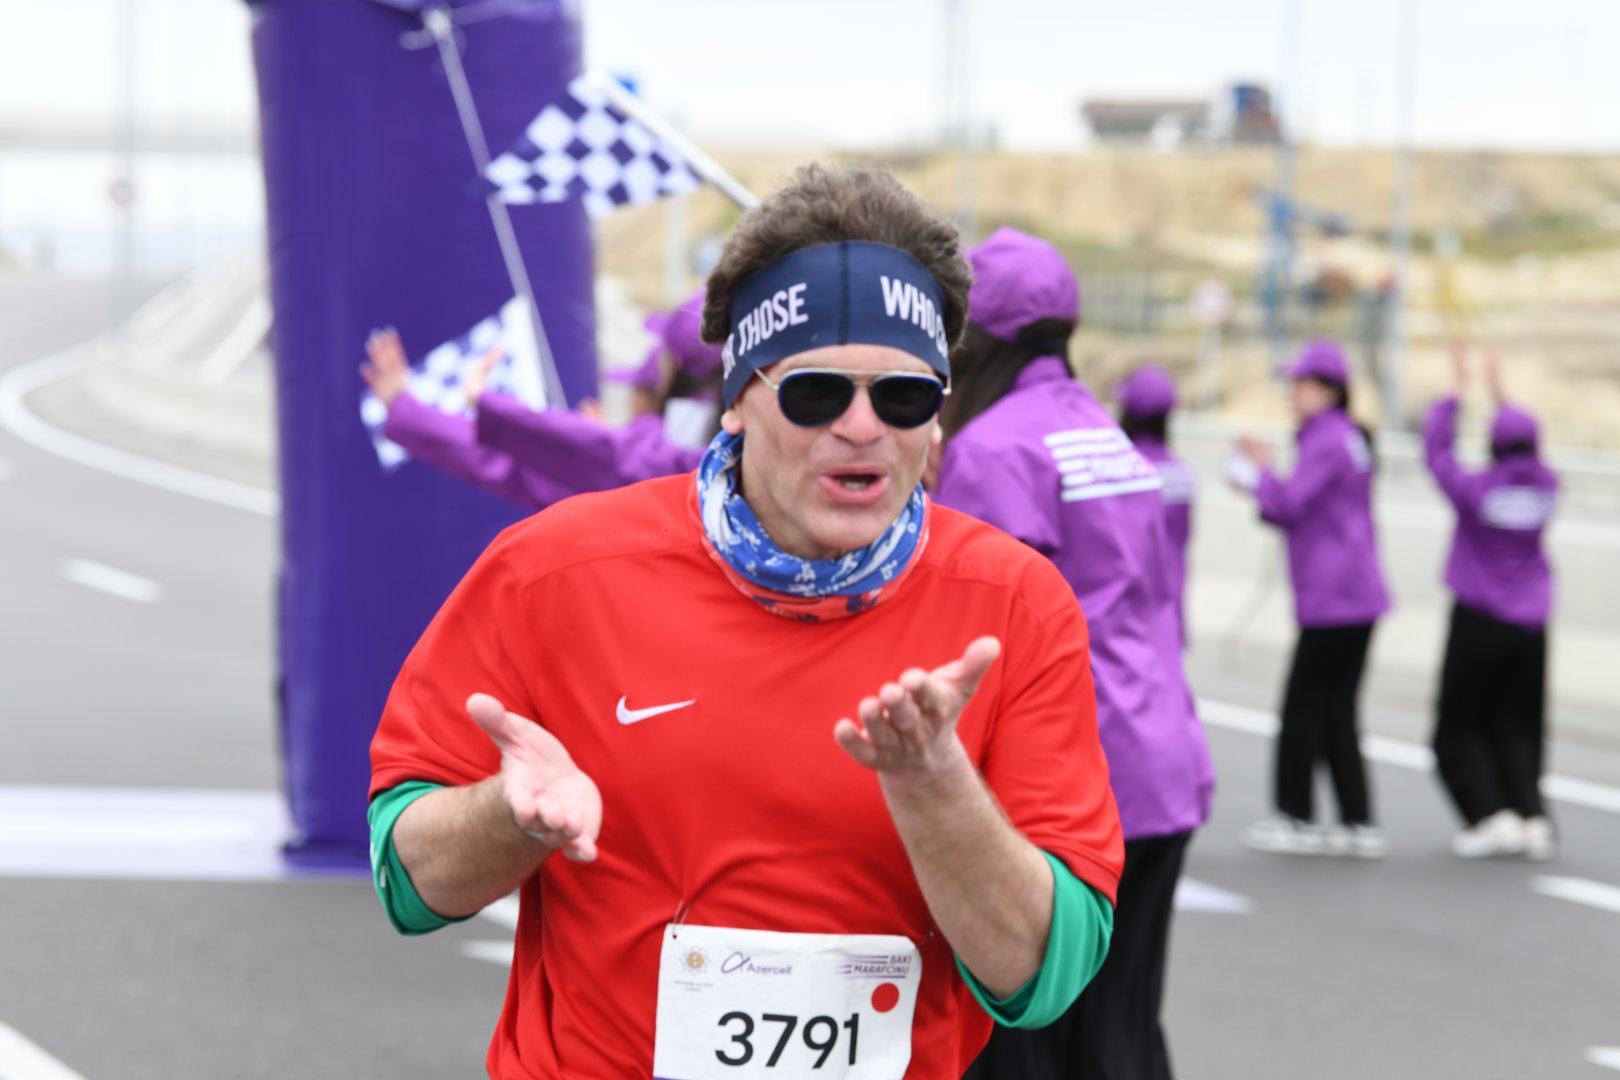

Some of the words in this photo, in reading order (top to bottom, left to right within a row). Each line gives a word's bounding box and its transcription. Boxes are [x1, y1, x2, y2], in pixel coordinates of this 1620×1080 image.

[738, 282, 809, 356] THOSE
[880, 275, 936, 339] WHO
[747, 963, 793, 975] Azercell
[715, 1011, 860, 1069] 3791
